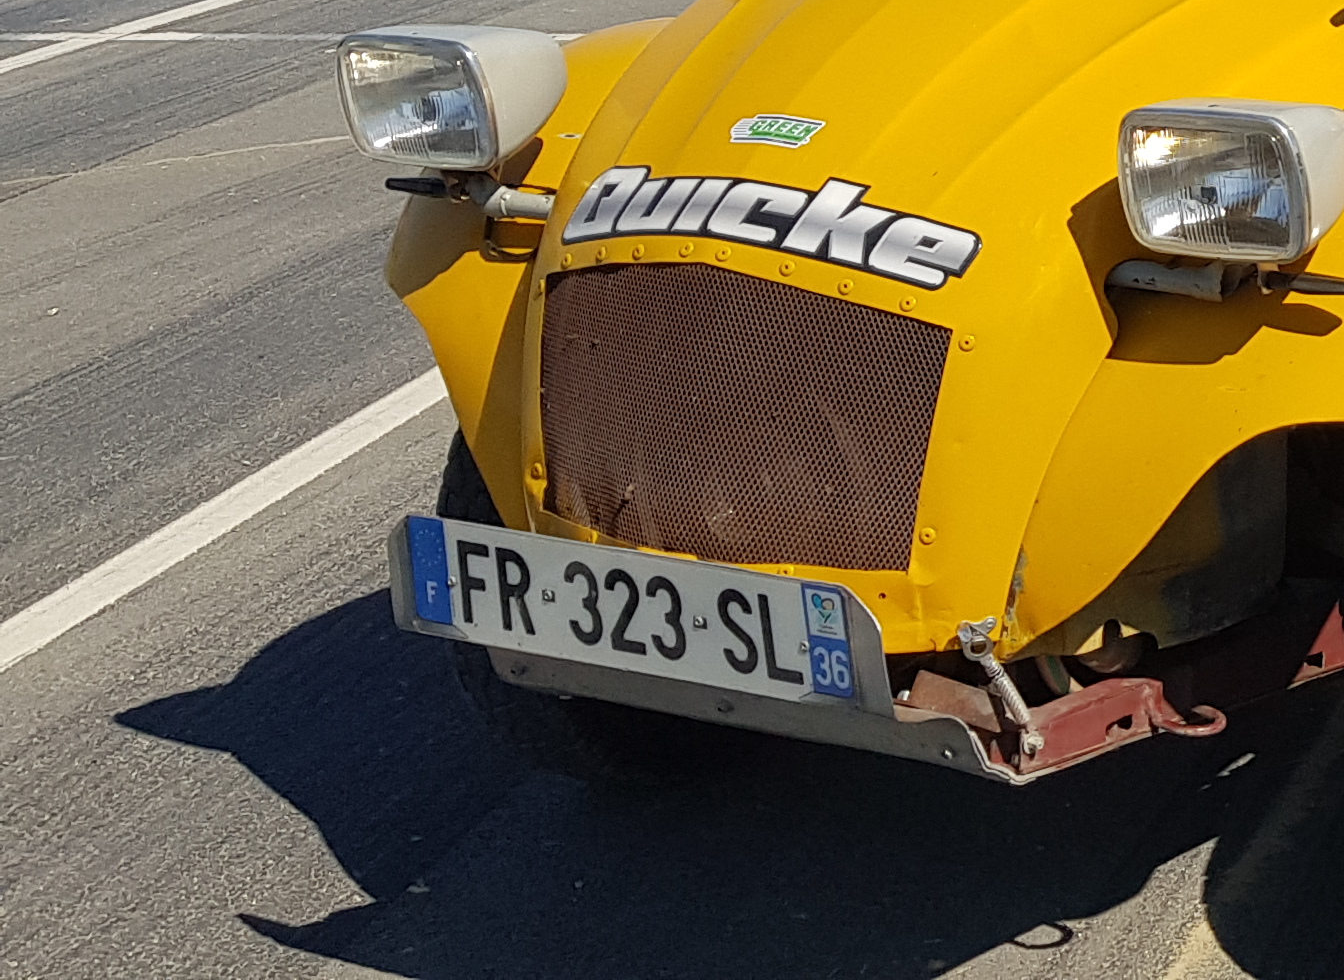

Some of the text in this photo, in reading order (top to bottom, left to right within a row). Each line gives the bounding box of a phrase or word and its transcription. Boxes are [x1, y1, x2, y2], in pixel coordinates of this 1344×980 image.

[563, 166, 978, 286] Quicke
[425, 539, 851, 690] F FR 323 SL 36
